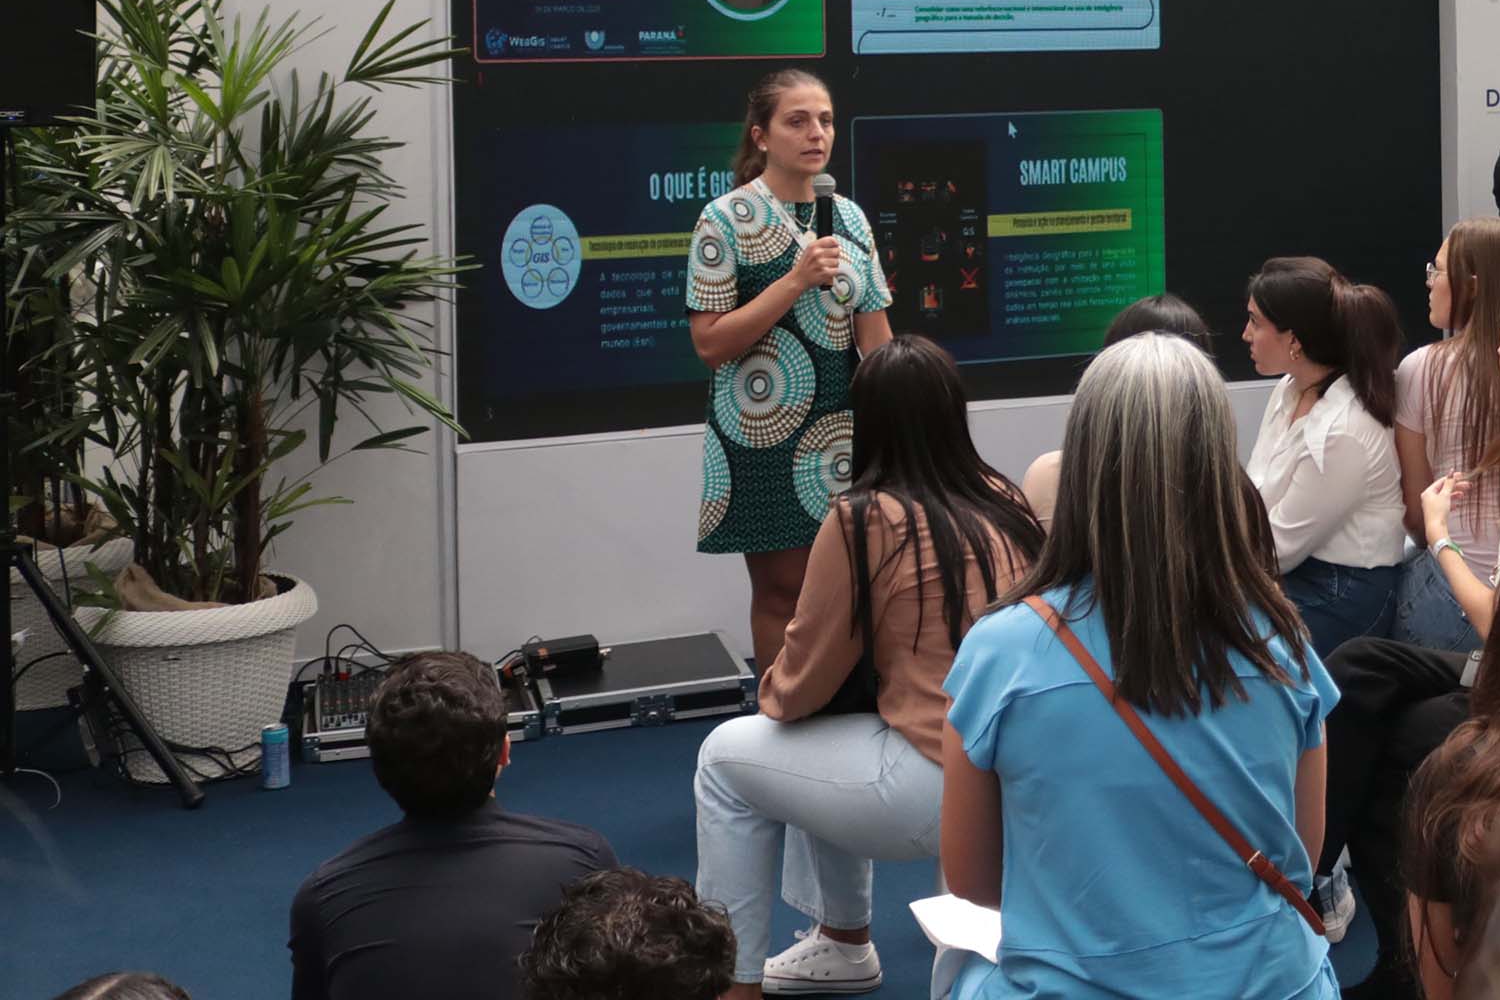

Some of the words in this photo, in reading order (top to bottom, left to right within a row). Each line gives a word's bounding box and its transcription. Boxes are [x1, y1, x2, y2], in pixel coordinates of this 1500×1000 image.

[649, 172, 660, 200] O
[664, 170, 694, 203] QUE
[697, 166, 706, 199] É
[1020, 158, 1067, 186] SMART
[1070, 156, 1127, 184] CAMPUS
[533, 252, 550, 264] GIS
